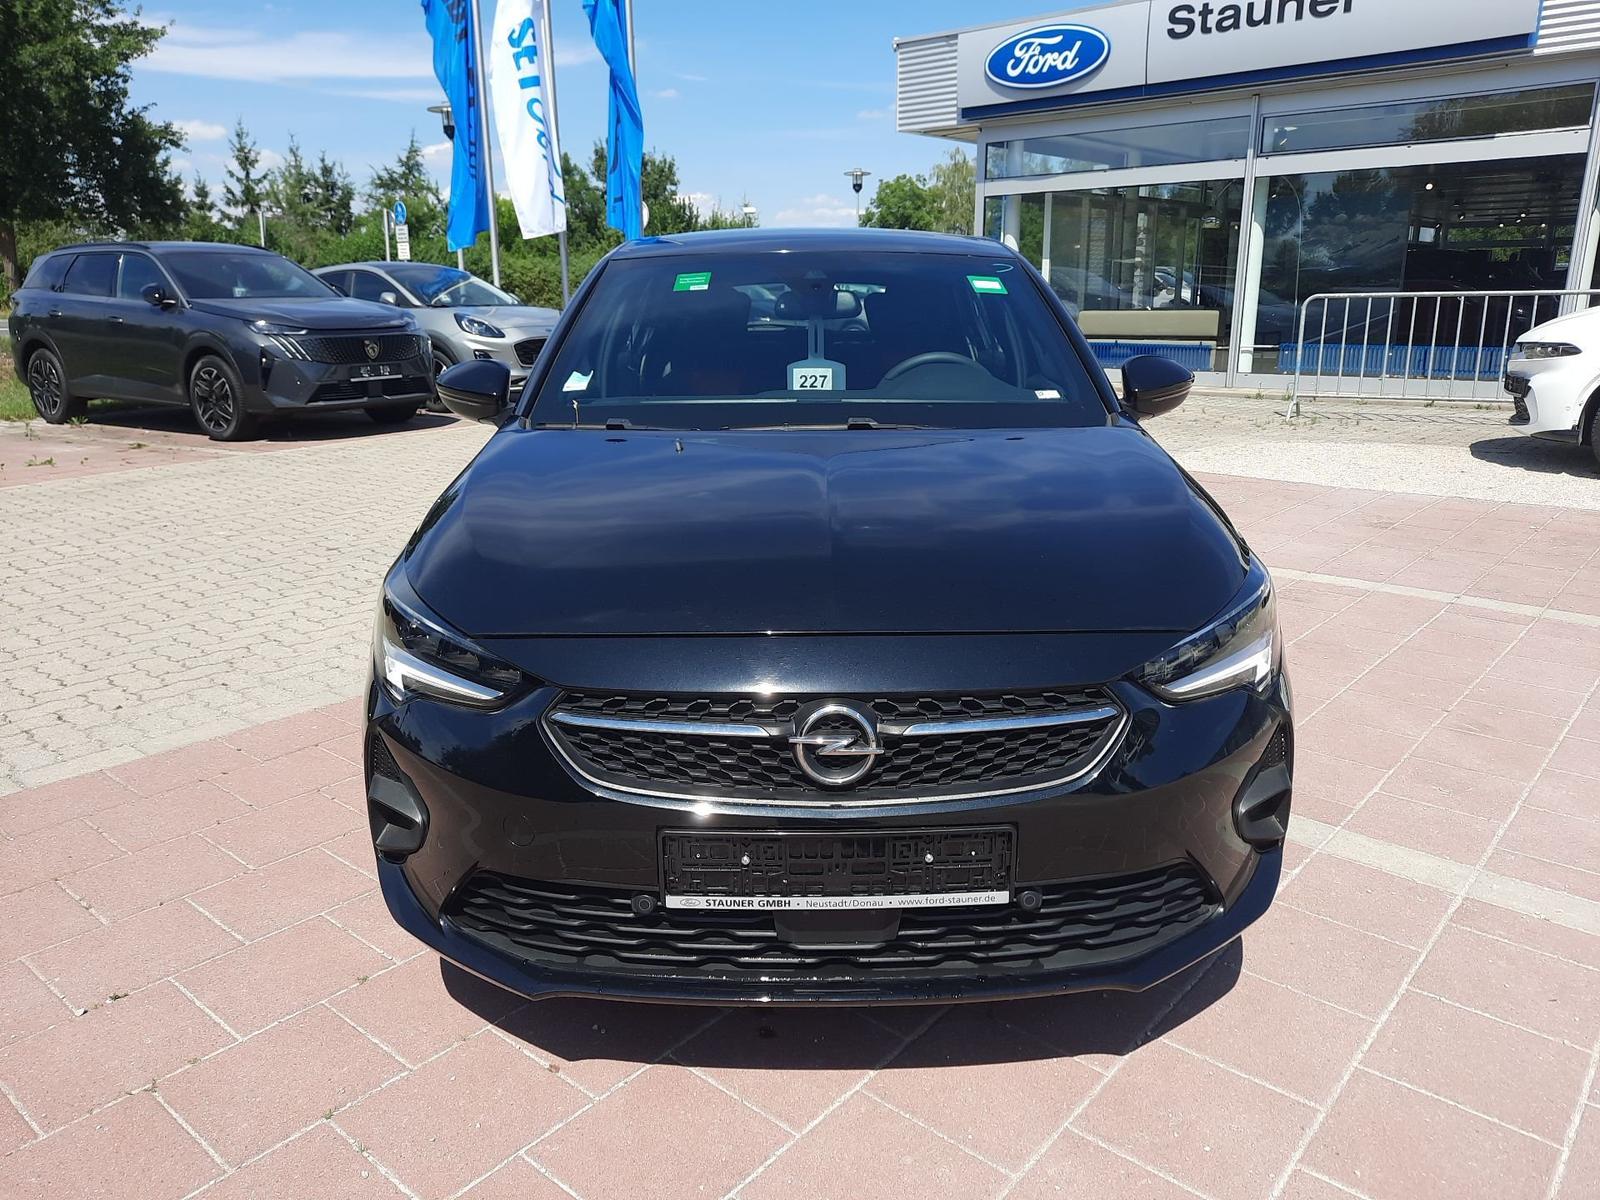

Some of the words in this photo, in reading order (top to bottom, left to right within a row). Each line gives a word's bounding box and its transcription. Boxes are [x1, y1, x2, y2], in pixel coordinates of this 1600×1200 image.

[1006, 35, 1082, 77] Ford
[799, 374, 828, 389] 227
[705, 899, 754, 908] STAUNER
[757, 899, 791, 908] GMBH
[805, 899, 884, 909] Neustadt/Donau
[897, 894, 996, 907] www.ford-stauner.de
